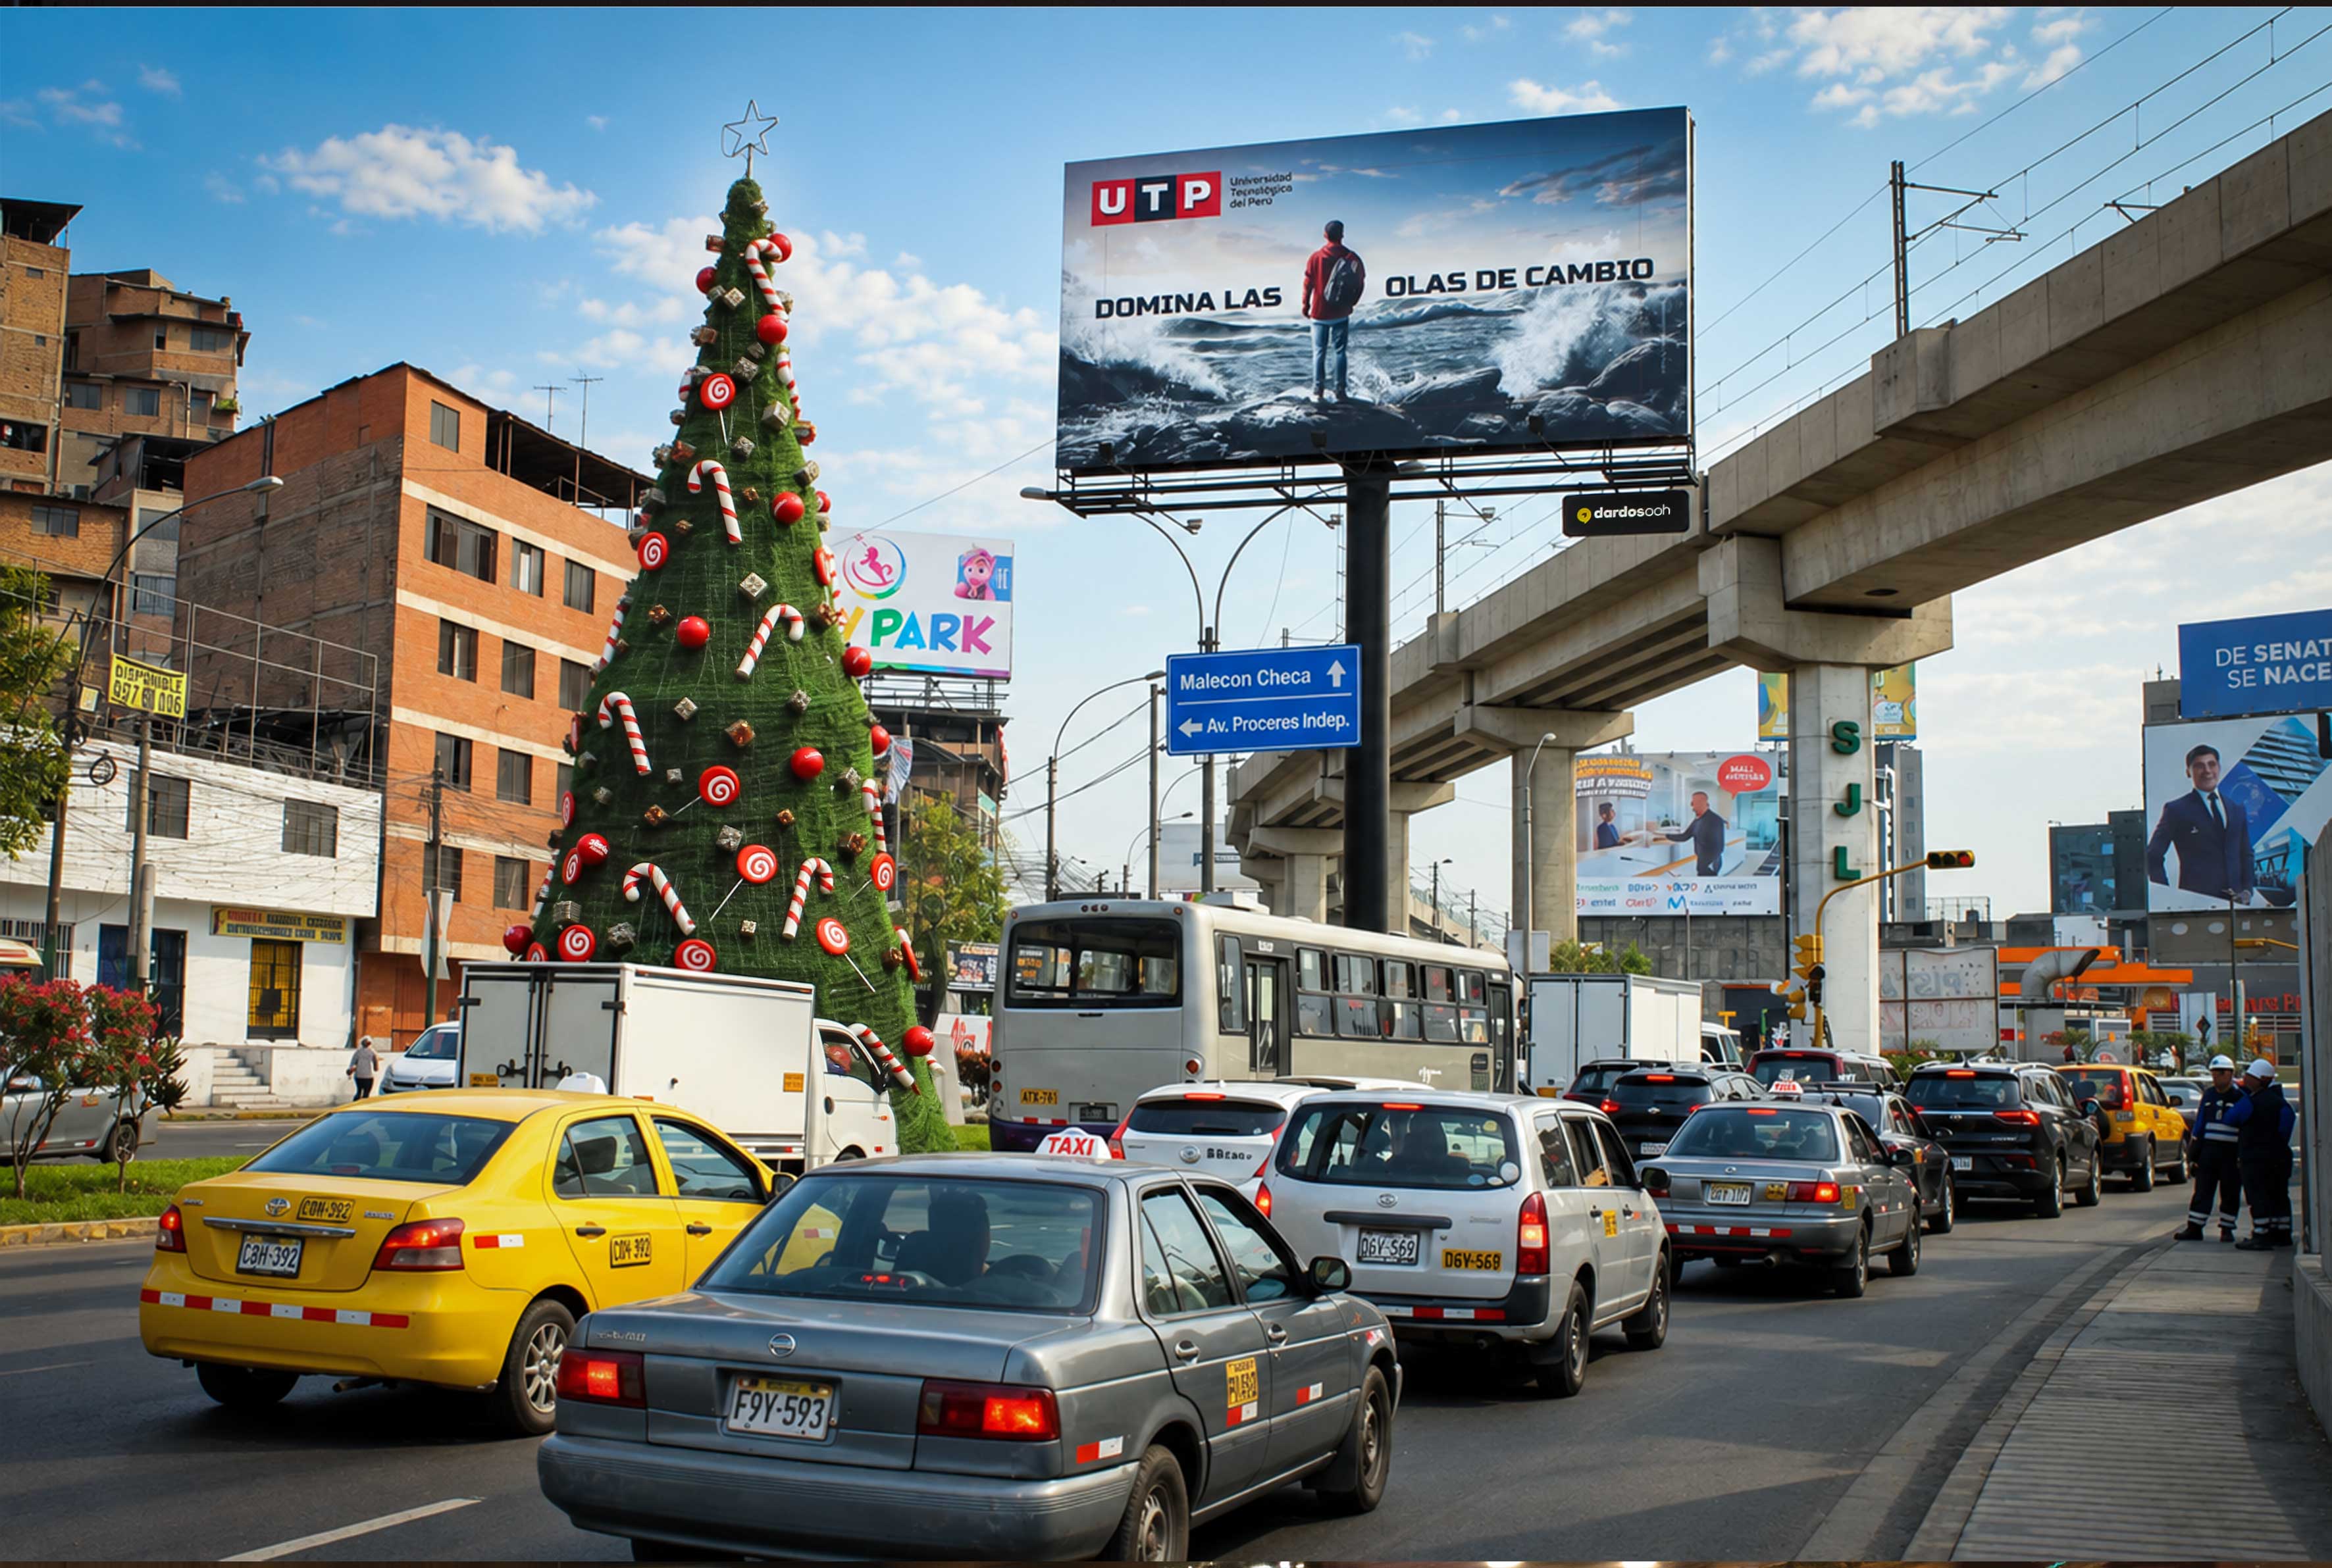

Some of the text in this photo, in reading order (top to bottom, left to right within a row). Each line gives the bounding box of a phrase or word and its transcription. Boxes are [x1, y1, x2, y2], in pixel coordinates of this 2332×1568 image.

[1230, 172, 1292, 186] Universidad
[1099, 179, 1211, 215] UTP
[1230, 196, 1272, 208] del Perú
[1386, 259, 1655, 297] OLAS DE CAMBIO
[1096, 287, 1282, 319] DOMINA LAS
[1594, 504, 1671, 518] dardosooh
[870, 609, 996, 655] PARK
[2215, 638, 2332, 667] DE SENAT
[1180, 669, 1311, 690] Malecon Checa
[2227, 662, 2332, 690] SE NACE
[1206, 711, 1350, 734] Av. Proceres Indep.
[1048, 1136, 1095, 1156] TAXI
[733, 1389, 825, 1429] F9Y-593
